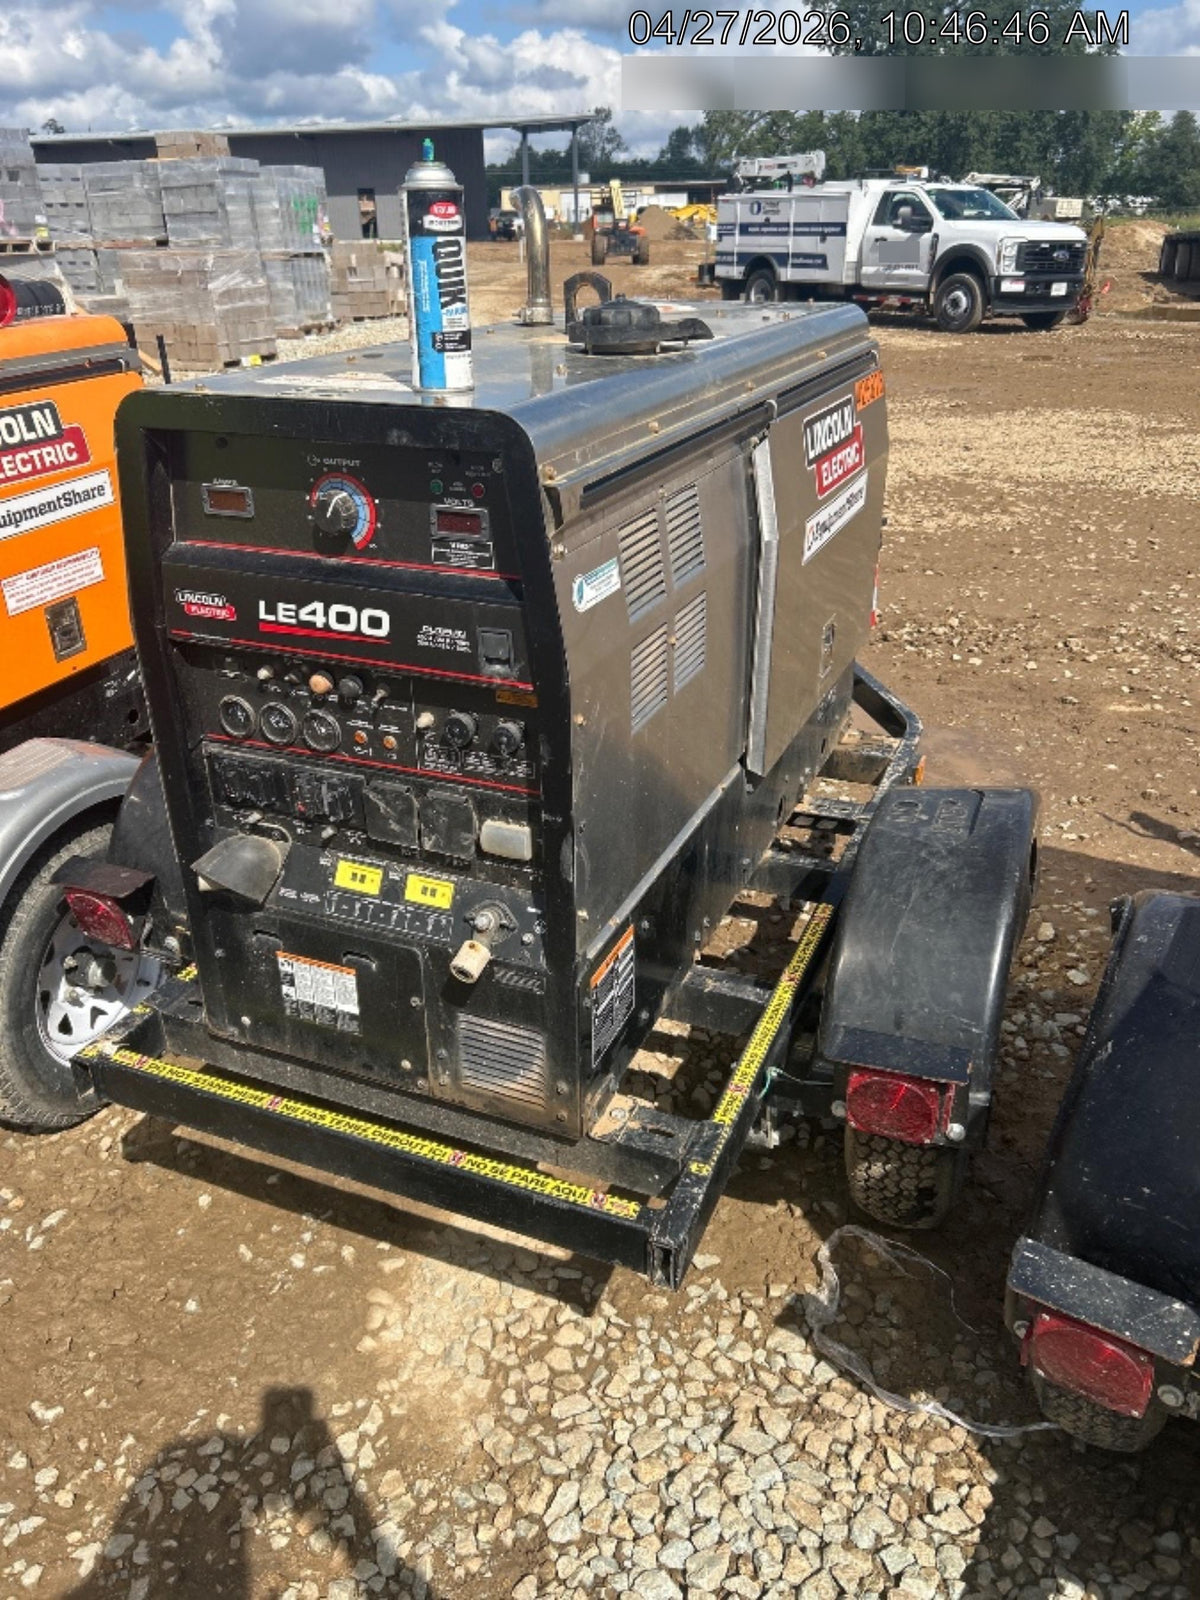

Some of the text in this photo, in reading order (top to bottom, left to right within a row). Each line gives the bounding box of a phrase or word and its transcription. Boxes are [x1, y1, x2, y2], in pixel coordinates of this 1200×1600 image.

[0, 408, 57, 445] OLN
[806, 405, 854, 459] LINCOLN
[821, 441, 860, 487] ELECTRIC
[177, 591, 225, 607] LINCOLN
[258, 599, 391, 638] LE400
[192, 1075, 233, 1093] STAND
[466, 1158, 488, 1170] NO
